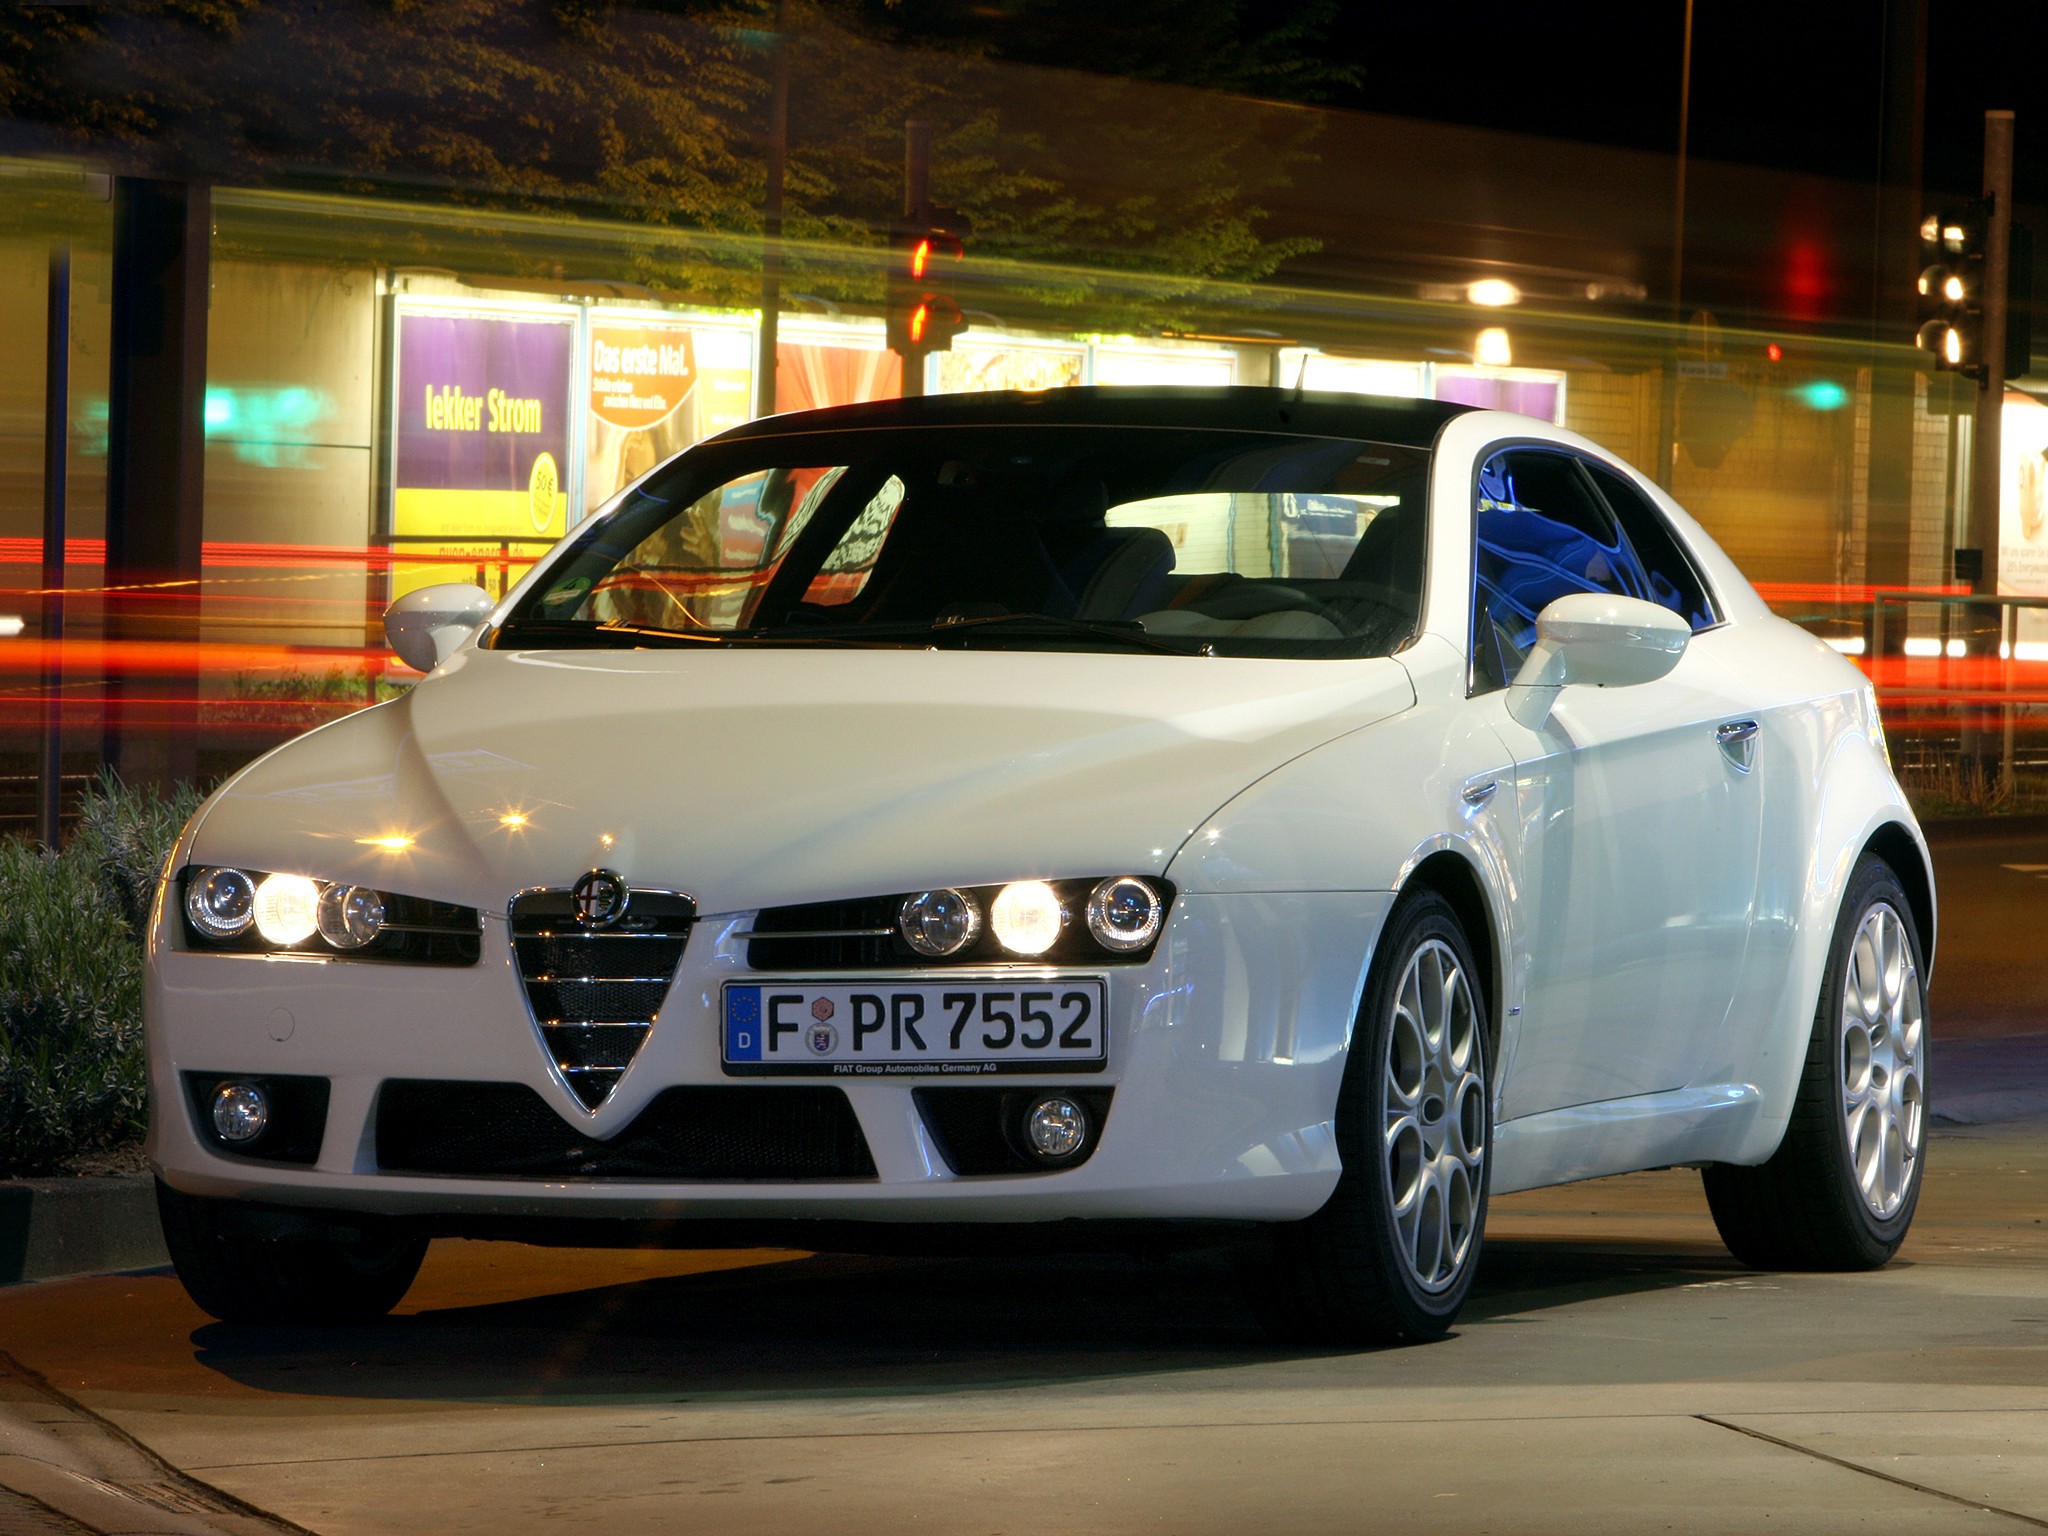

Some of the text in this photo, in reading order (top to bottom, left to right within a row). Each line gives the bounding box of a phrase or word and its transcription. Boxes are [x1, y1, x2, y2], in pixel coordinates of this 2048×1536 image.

[594, 340, 688, 376] Das erste Mal.
[426, 384, 541, 432] lekker Strom
[536, 471, 554, 497] 50 €
[767, 992, 1092, 1052] F PR 7552
[739, 1032, 751, 1048] D
[833, 1063, 997, 1074] FIAT Group Automobiles Germany AG
